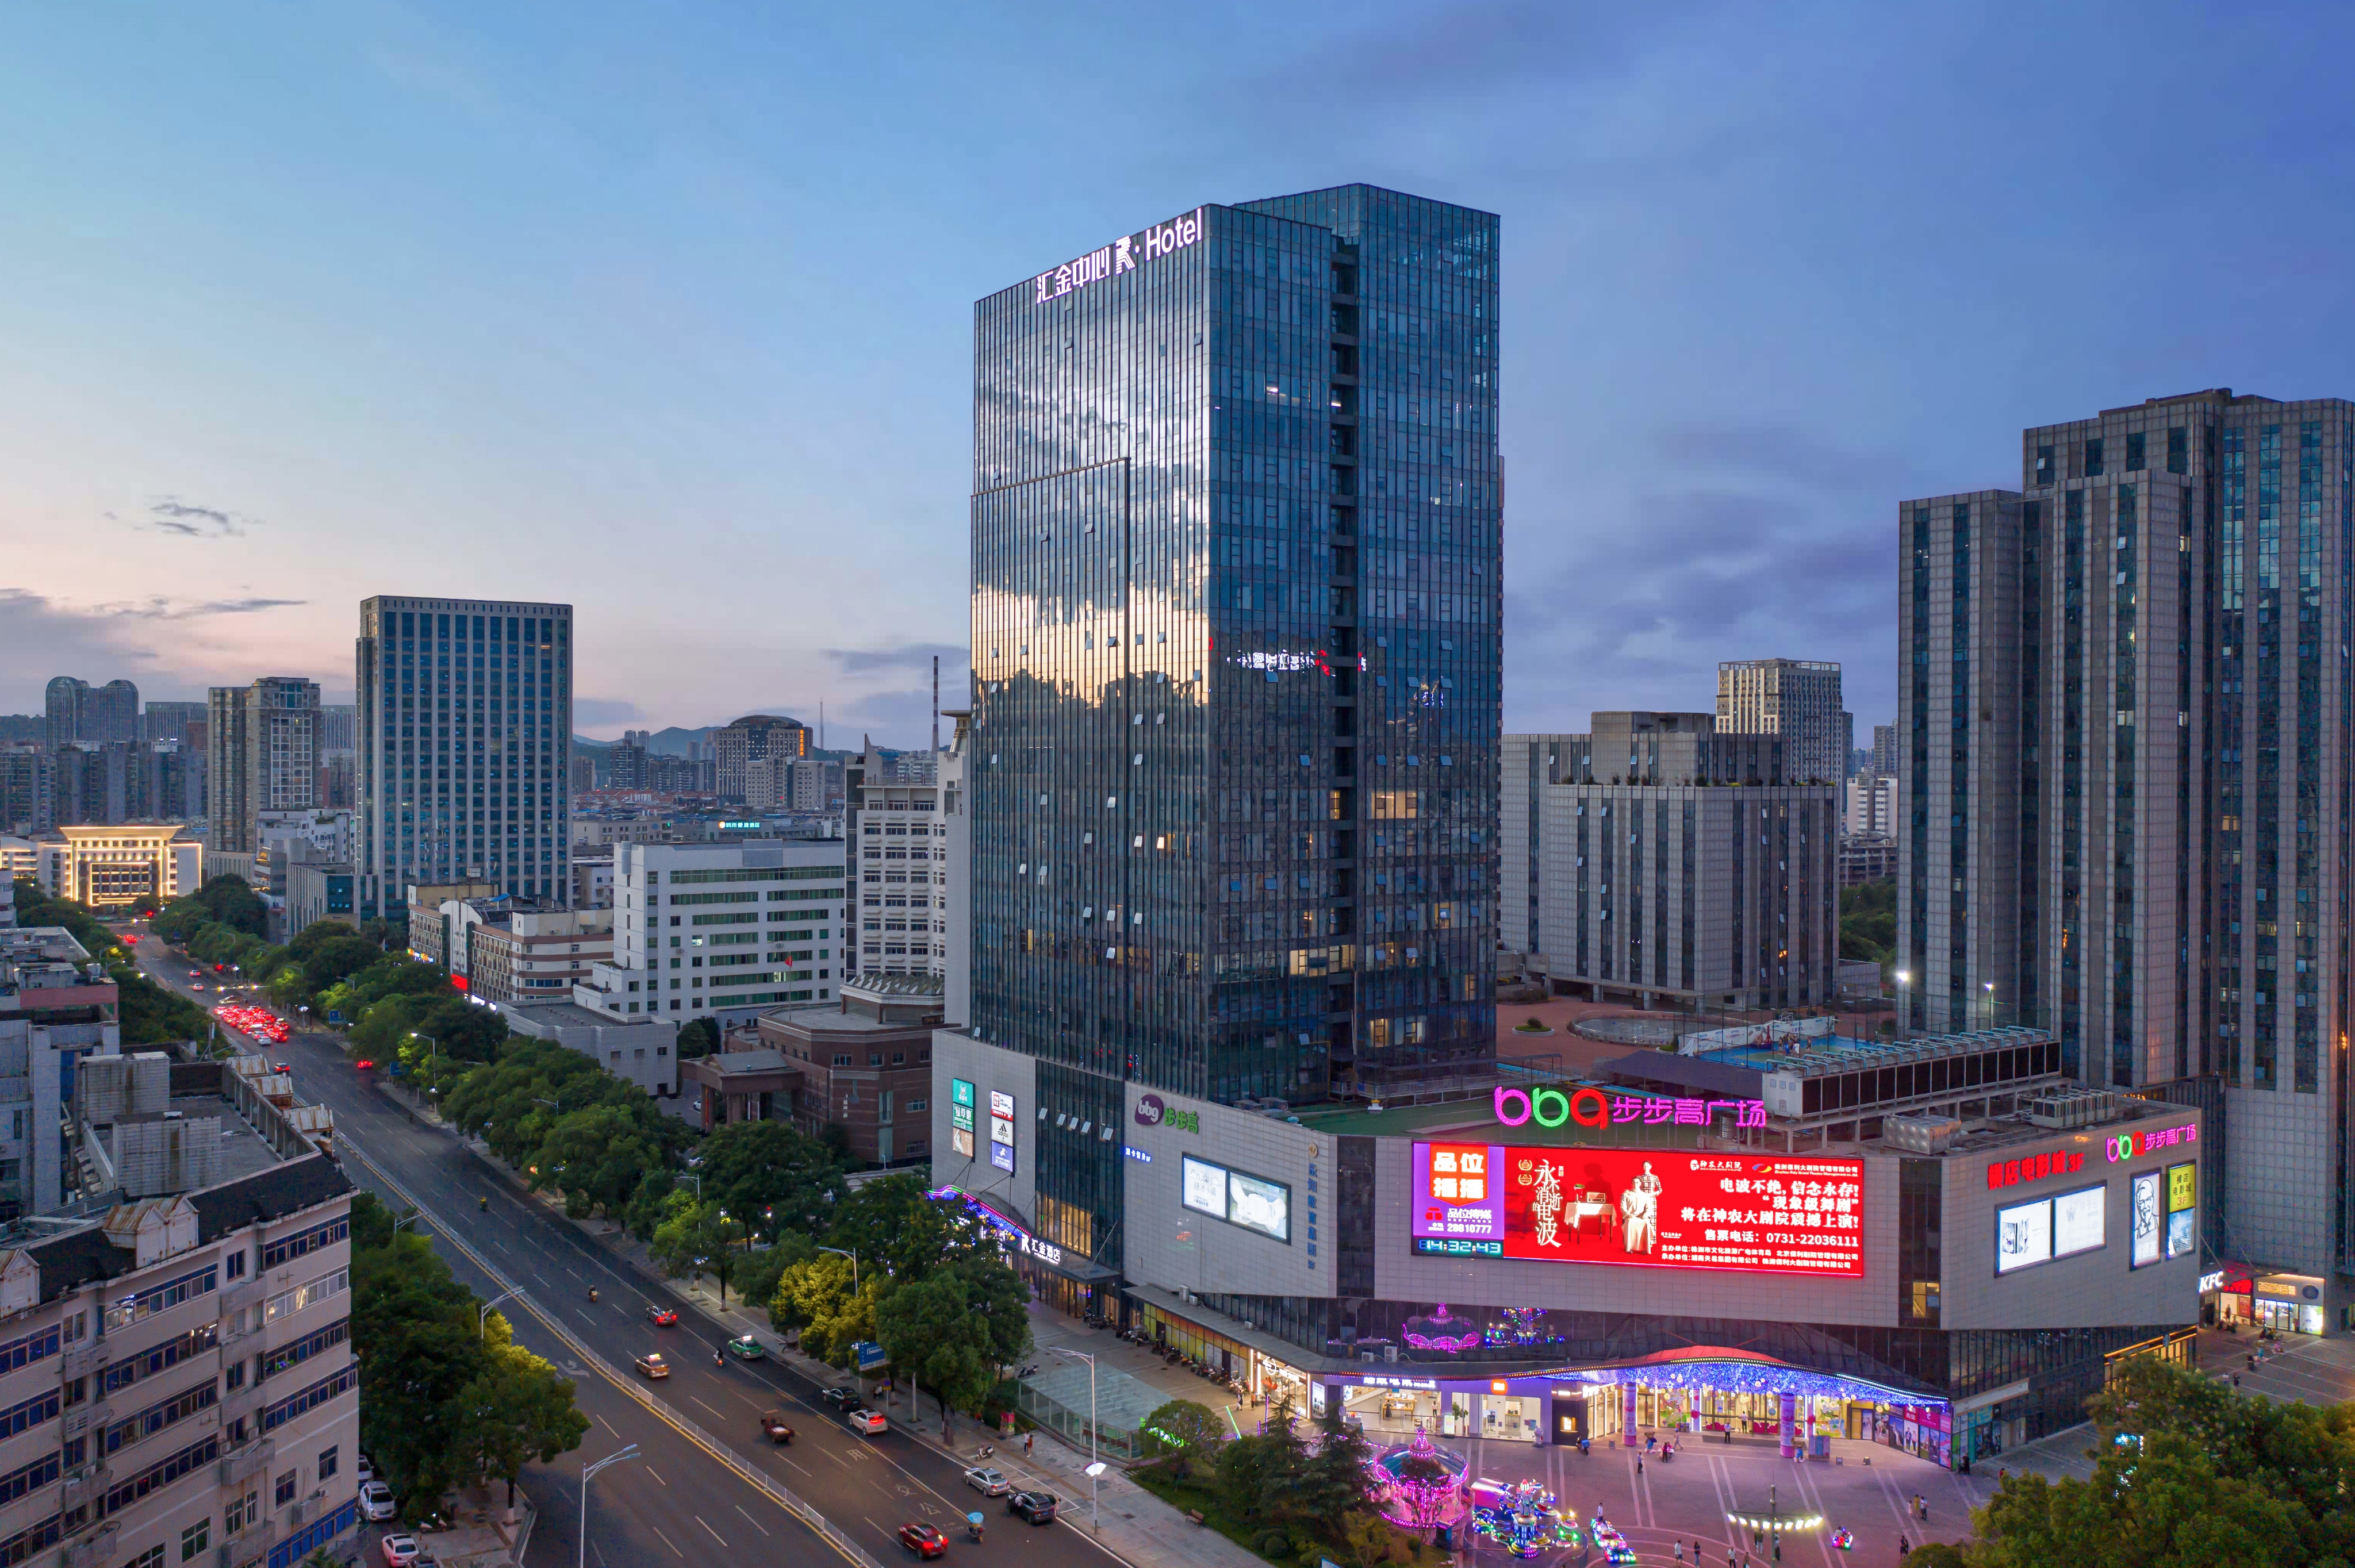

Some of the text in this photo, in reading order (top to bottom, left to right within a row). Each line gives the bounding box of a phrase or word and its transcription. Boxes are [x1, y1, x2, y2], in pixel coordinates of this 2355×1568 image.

[1036, 247, 1110, 304] 汇金中心
[1138, 1100, 1199, 1134] bbg 步步高
[1613, 1097, 1767, 1128] 步步高广场
[2145, 1124, 2196, 1151] 步步高广场
[1434, 1152, 1484, 1173] 品位
[1700, 1160, 1742, 1169] 神农大剧院
[1774, 1163, 1858, 1173] 株洲保利大剧院管理有限公司
[1988, 1150, 2085, 1190] 横店电影城 3F
[2177, 1173, 2189, 1184] 横店
[2173, 1183, 2192, 1195] 电影城
[1307, 1163, 1317, 1257] 乐知教育集团
[2177, 1196, 2187, 1206] 3F
[1447, 1223, 1492, 1233] 28810777
[1766, 1232, 1859, 1247] 0731-22036111
[1031, 1238, 1061, 1262] 汇金酒店
[1776, 1250, 1858, 1260] 北京保利剧院管理有限公司
[2135, 1240, 2157, 1260] 肯德基
[1762, 1258, 1851, 1269] 株洲保利大剧院管理有限公司
[2199, 1271, 2224, 1293] KFC
